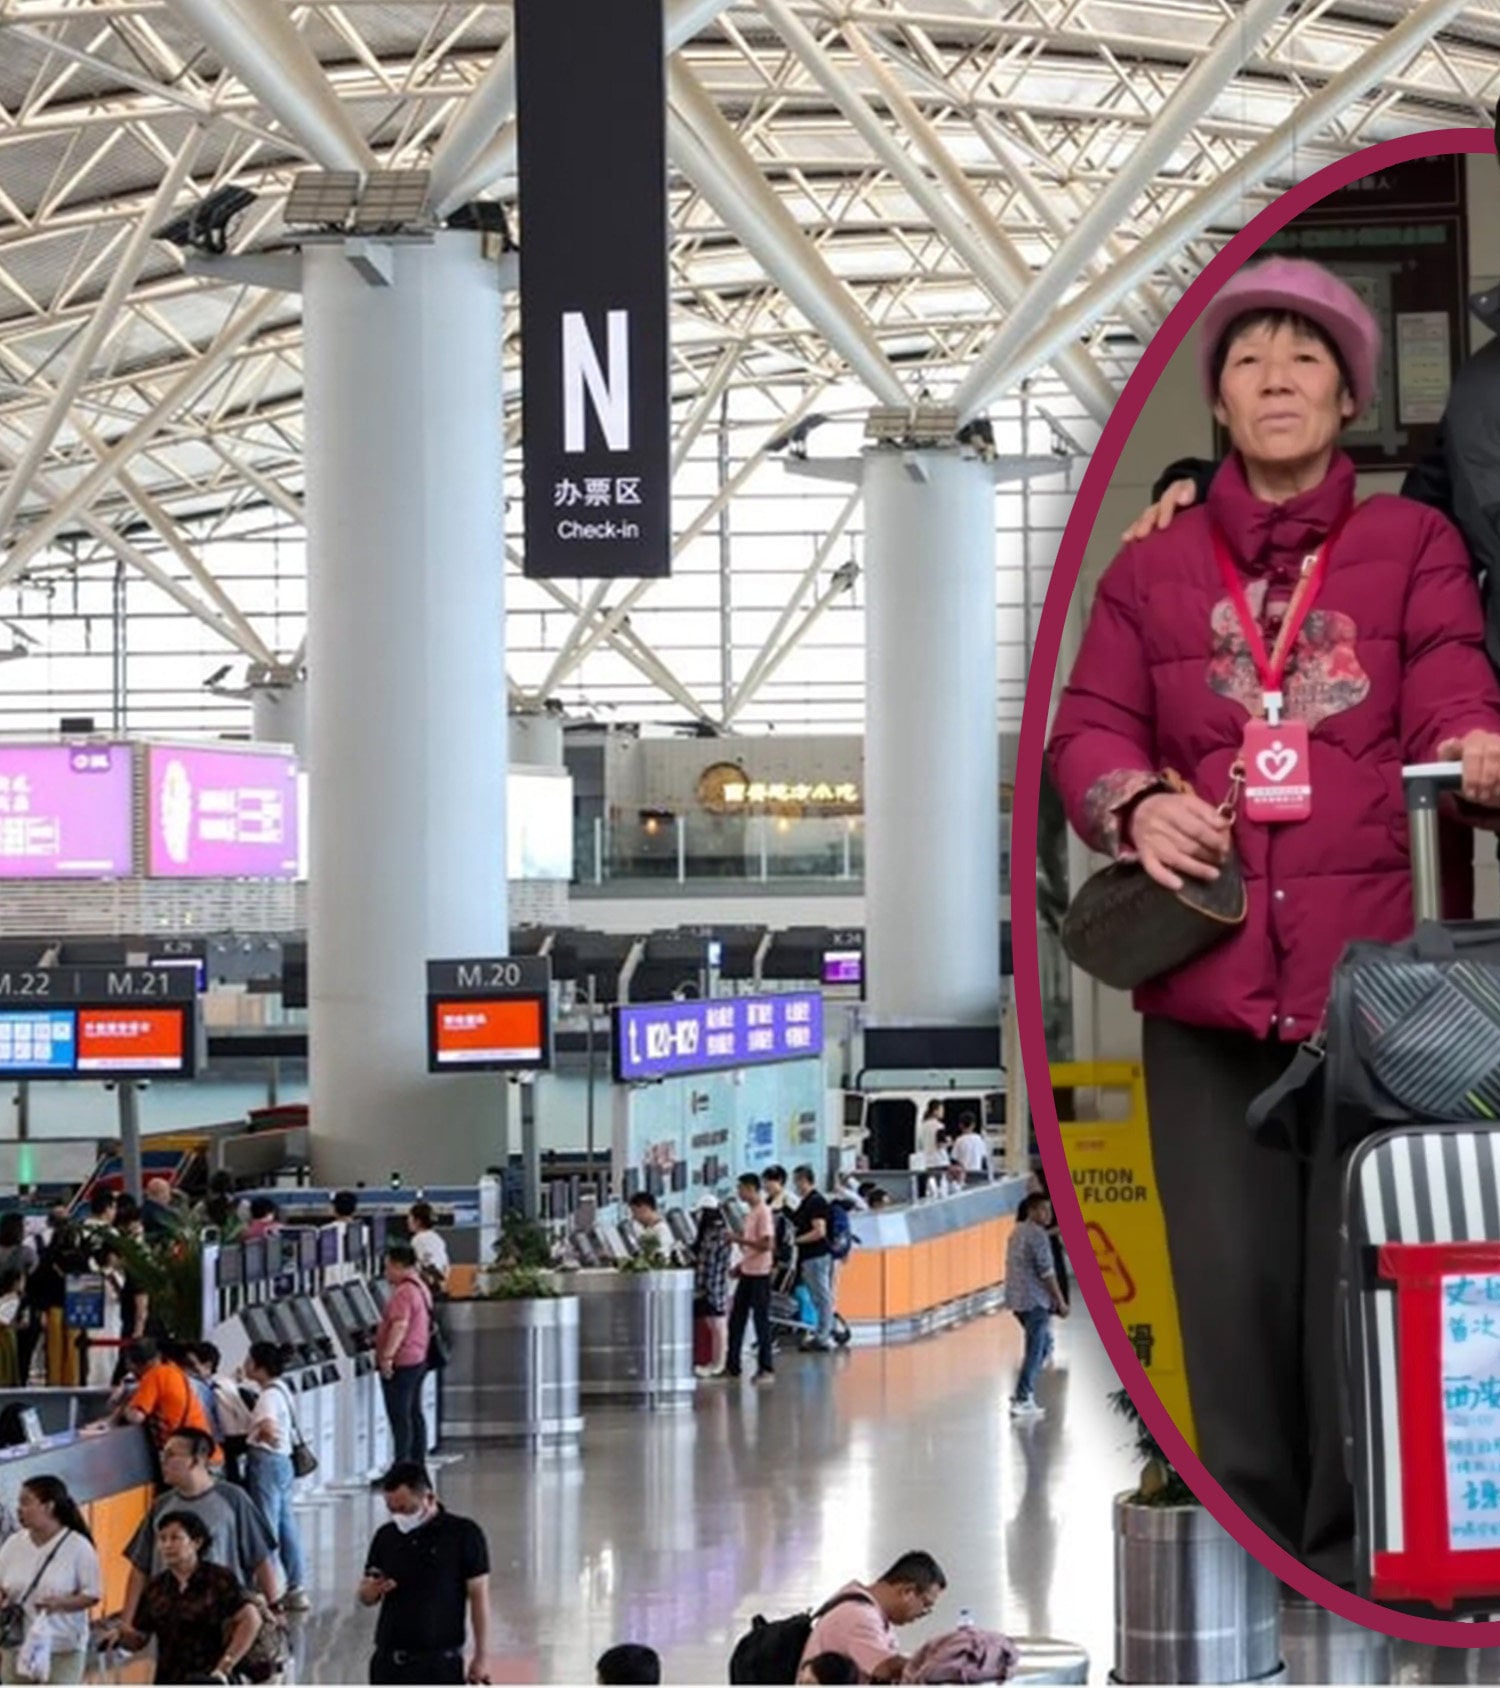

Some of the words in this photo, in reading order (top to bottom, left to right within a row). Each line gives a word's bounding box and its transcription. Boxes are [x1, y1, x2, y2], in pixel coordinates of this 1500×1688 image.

[562, 310, 630, 453] N
[554, 478, 642, 506] 办票区
[557, 519, 640, 540] Check-in
[108, 972, 169, 994] M.21
[458, 963, 520, 987] M.20
[1072, 1168, 1133, 1185] UTION
[1083, 1186, 1147, 1203] FLOOR
